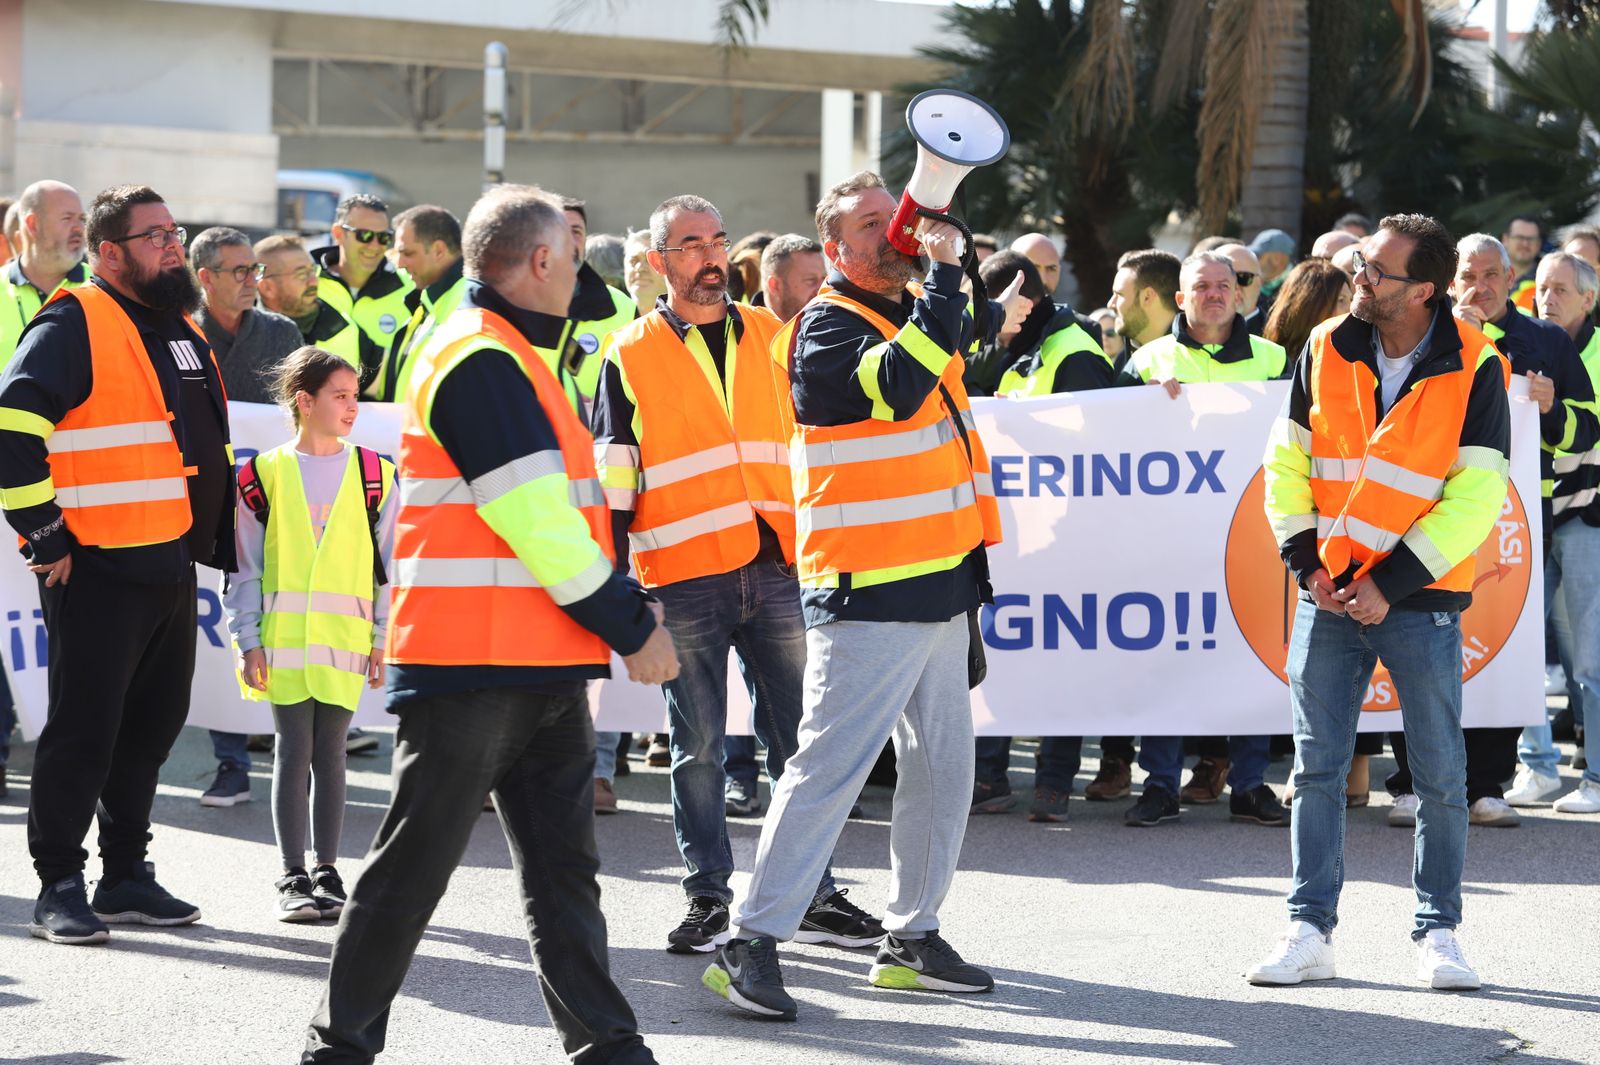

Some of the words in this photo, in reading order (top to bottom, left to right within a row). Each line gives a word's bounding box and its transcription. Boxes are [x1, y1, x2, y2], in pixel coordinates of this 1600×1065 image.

[991, 449, 1227, 497] ERINOX
[1495, 496, 1525, 565] RÁS!
[980, 591, 1218, 651] GNO!!
